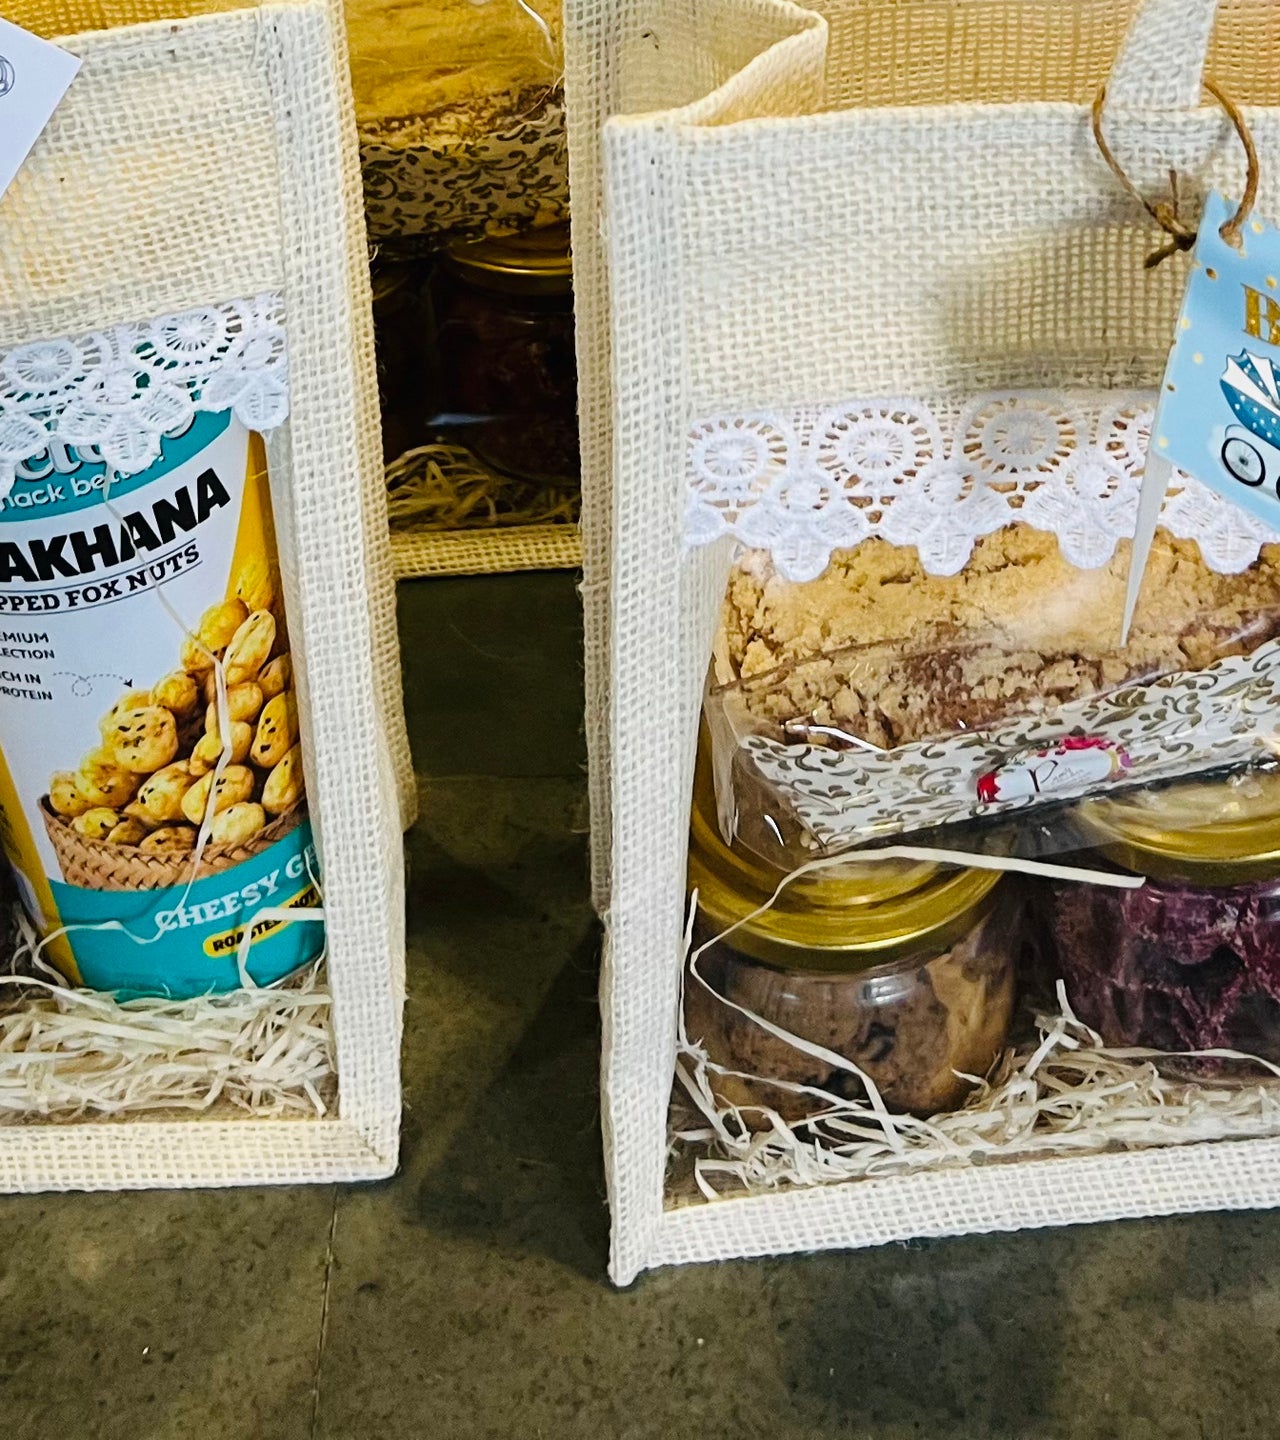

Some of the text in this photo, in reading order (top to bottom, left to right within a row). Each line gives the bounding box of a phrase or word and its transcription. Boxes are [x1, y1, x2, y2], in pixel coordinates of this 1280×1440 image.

[69, 579, 122, 607] FOX
[125, 543, 200, 591] NUTS
[25, 674, 41, 684] IN
[154, 869, 280, 931] CHEESY
